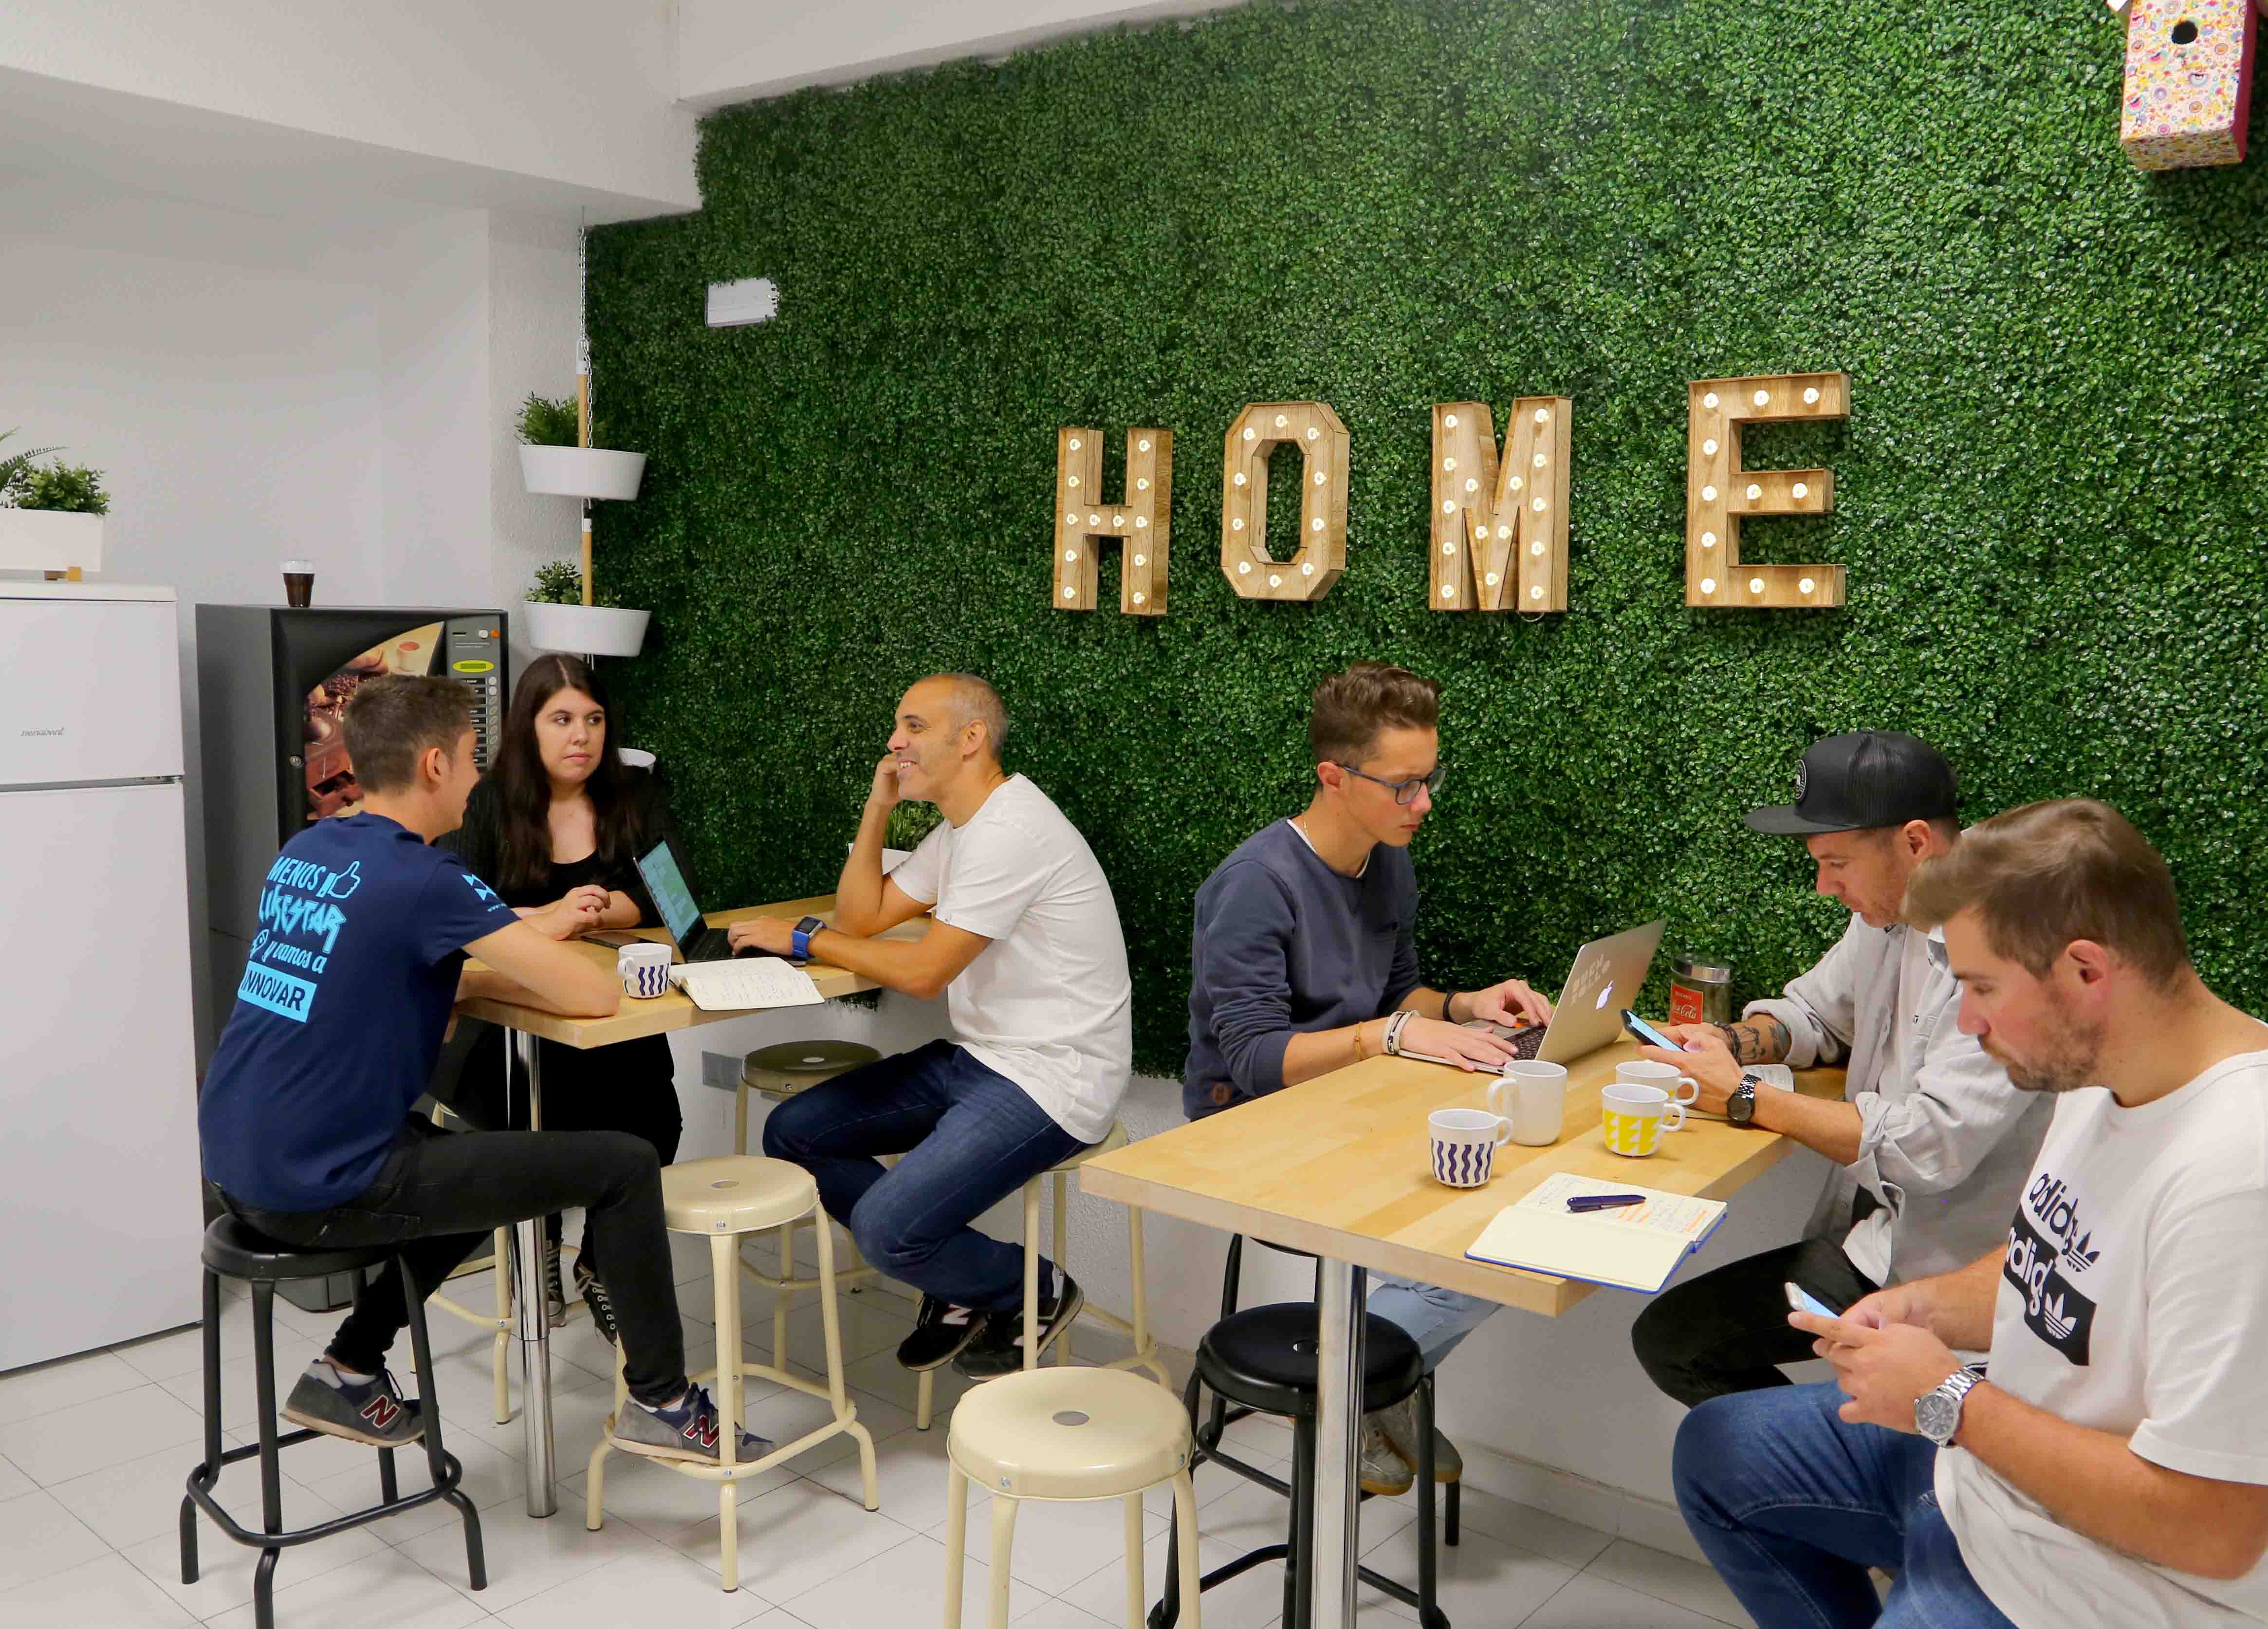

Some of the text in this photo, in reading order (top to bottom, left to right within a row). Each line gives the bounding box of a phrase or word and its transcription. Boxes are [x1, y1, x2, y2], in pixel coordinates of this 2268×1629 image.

[1052, 372, 1851, 616] HOME
[267, 856, 326, 890] MENOS
[261, 941, 277, 963] y
[312, 956, 327, 973] a
[241, 969, 306, 1011] INNOVAR
[361, 1394, 401, 1428] N
